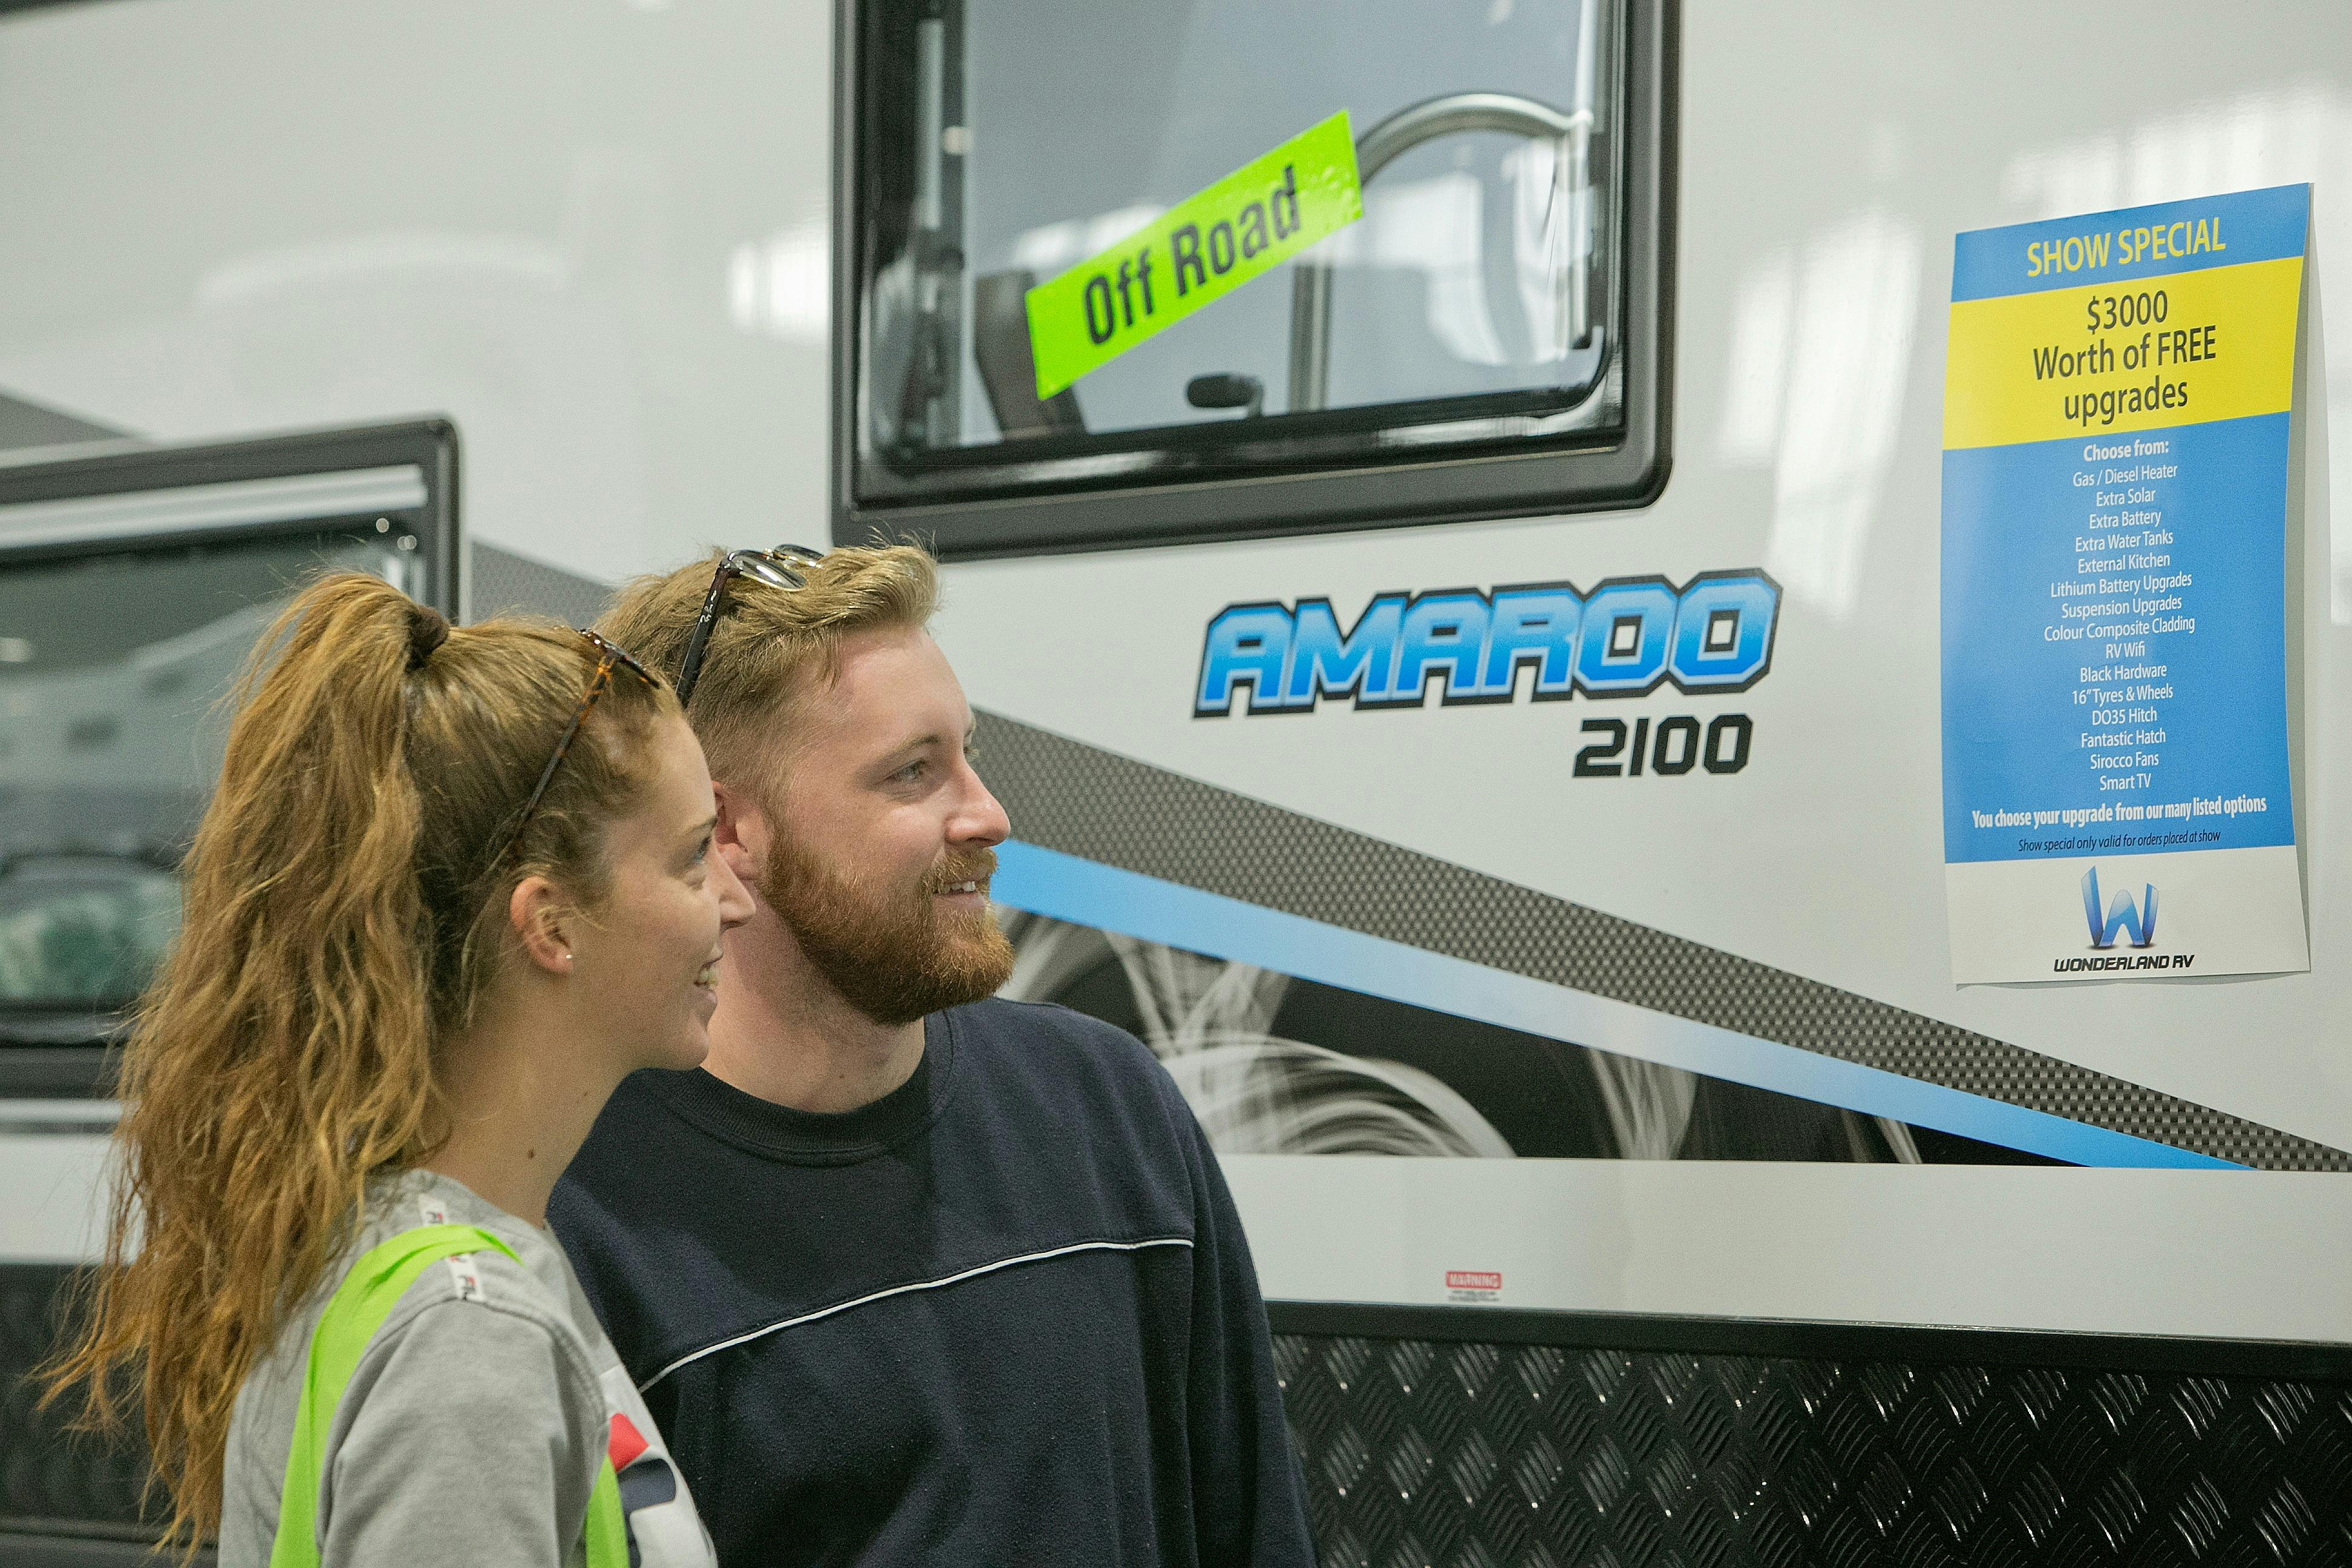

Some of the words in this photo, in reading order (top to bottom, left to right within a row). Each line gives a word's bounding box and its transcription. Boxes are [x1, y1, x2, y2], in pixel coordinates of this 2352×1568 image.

[1083, 247, 1155, 345] Off
[1171, 164, 1300, 297] Road
[2027, 233, 2110, 276] SHOW
[2118, 217, 2226, 264] SPECIAL
[2088, 290, 2167, 335] $3000
[2034, 339, 2114, 380] Worth
[2123, 333, 2151, 370] of
[2158, 325, 2215, 365] FREE
[2065, 375, 2187, 426] upgrades
[2083, 445, 2131, 462] Choose
[2134, 439, 2168, 456] from:
[2073, 472, 2094, 486] Gas
[2105, 466, 2138, 484] Diesel
[2141, 465, 2177, 480] Heater
[2096, 492, 2125, 506] Extra
[2128, 487, 2155, 503] Solar
[2089, 514, 2118, 529] Extra
[2122, 511, 2161, 527] Battery
[2076, 537, 2105, 552] Extra
[2108, 534, 2141, 549] Water
[2142, 529, 2173, 546] Tanks
[2078, 555, 2125, 573] External
[2129, 552, 2170, 569] Kitchen
[2051, 581, 2096, 597] Lithium
[2099, 579, 2140, 595] Battery
[2143, 572, 2192, 593] Upgrades
[2062, 601, 2129, 621] Suspension
[2132, 595, 2181, 616] Upgrades
[2044, 625, 2083, 641] Colour
[2086, 621, 2149, 640] Composite
[2152, 616, 2195, 633] Cladding
[1192, 568, 1782, 718] AMAROO
[2106, 644, 2122, 658] RV
[2124, 641, 2145, 657] Wifi
[2080, 666, 2111, 682] Black
[2114, 663, 2166, 680] Hardware
[2091, 688, 2123, 707] Tyres
[2126, 687, 2134, 701] &
[2137, 684, 2173, 700] Wheels
[2092, 710, 2125, 725] DO35
[2129, 707, 2157, 723] Hitch
[1573, 714, 1753, 778] 2100
[2082, 731, 2133, 748] Fantastic
[2136, 728, 2166, 744] Hatch
[2091, 754, 2132, 769] Sirocco
[2135, 751, 2158, 766] Fans
[2100, 776, 2134, 791] Smart
[2137, 773, 2151, 788] TV
[1972, 811, 1993, 828] You
[1994, 809, 2031, 826] choose
[2033, 811, 2060, 829] your
[2062, 803, 2112, 828] upgrade
[2115, 802, 2144, 820] from
[2146, 805, 2163, 819] our
[2165, 803, 2192, 821] many
[2193, 796, 2221, 815] listed
[2224, 794, 2267, 818] options
[2019, 839, 2042, 852] Show
[2043, 837, 2076, 854] special
[2077, 836, 2097, 851] only
[2099, 835, 2122, 848] valid
[2123, 833, 2136, 848] for
[2138, 832, 2162, 846] orders
[2163, 830, 2188, 849] placed
[2189, 831, 2197, 843] at
[2198, 829, 2221, 842] show
[2054, 956, 2169, 972] WONDERLAND
[2172, 955, 2194, 968] RV
[1449, 1273, 1498, 1287] WARNING
